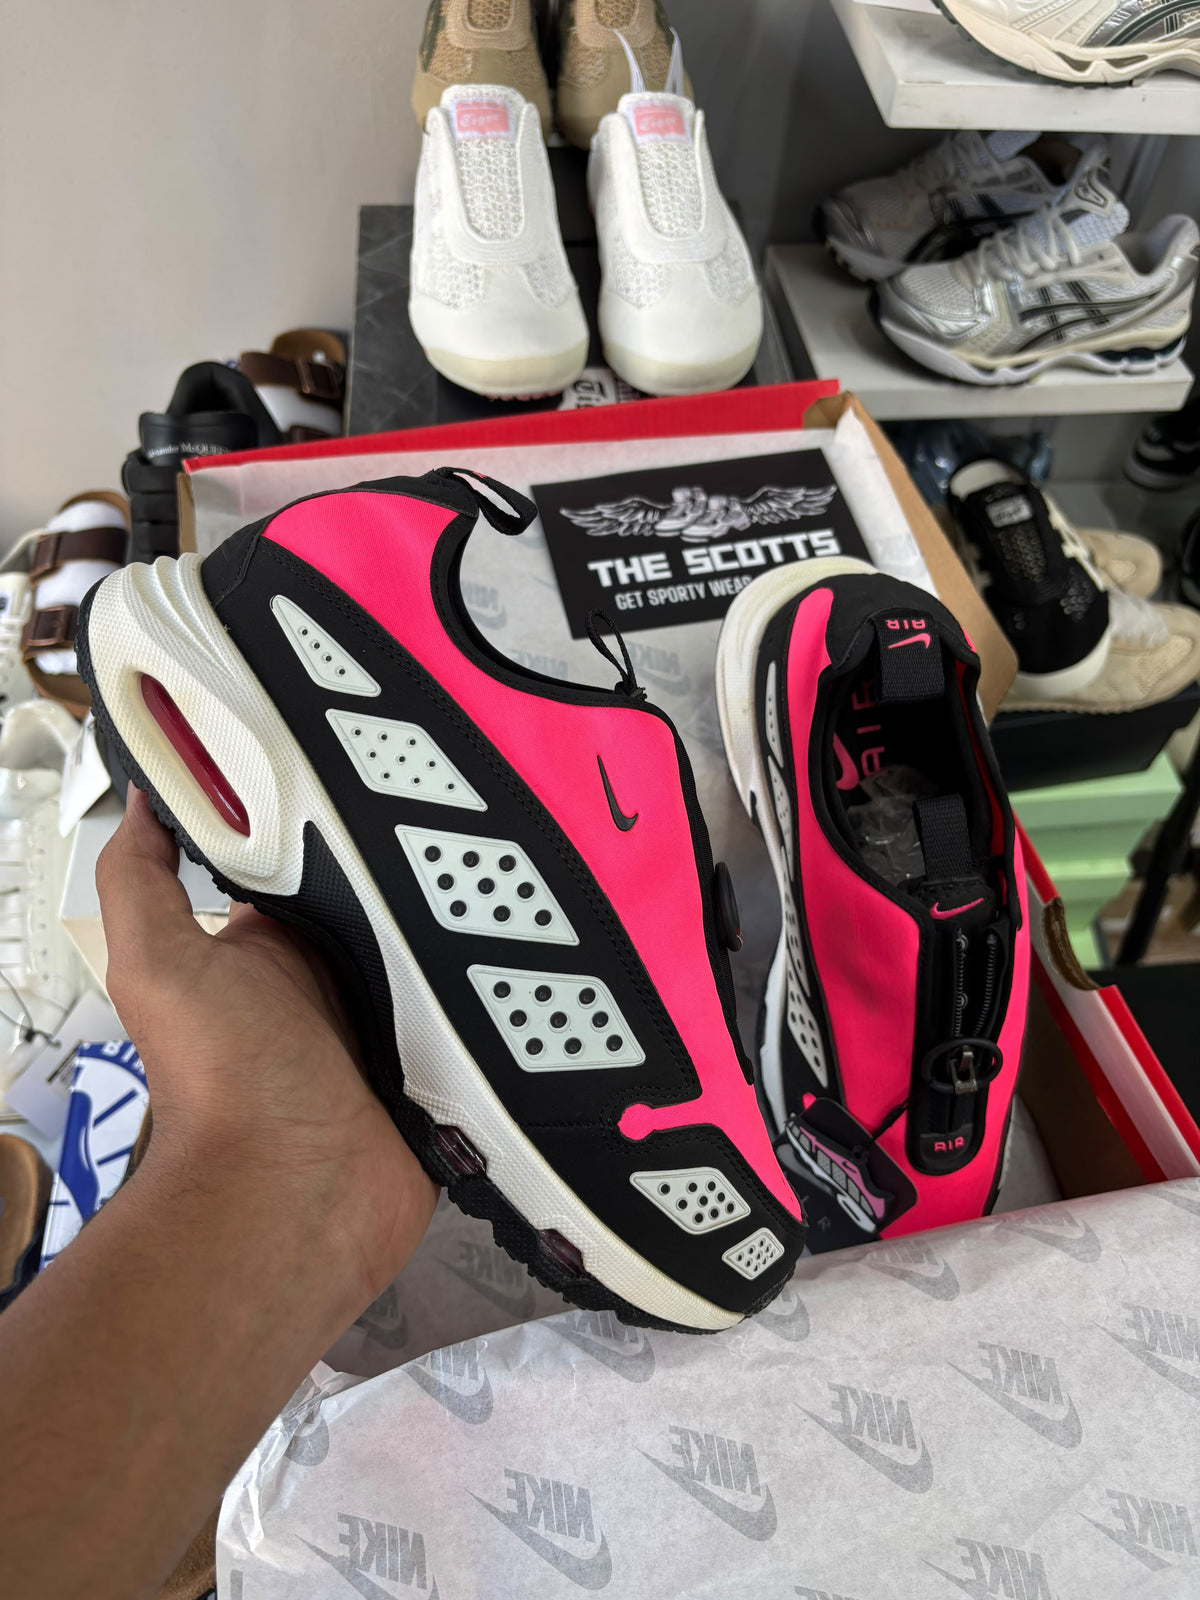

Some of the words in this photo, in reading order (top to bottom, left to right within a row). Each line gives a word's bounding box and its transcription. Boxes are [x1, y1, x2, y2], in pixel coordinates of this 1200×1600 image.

[587, 553, 672, 587] THE
[681, 528, 841, 575] SCOTTS
[615, 591, 643, 610] GET
[646, 581, 707, 607] SPORTY
[885, 618, 926, 630] AIR
[934, 1136, 965, 1153] AIR
